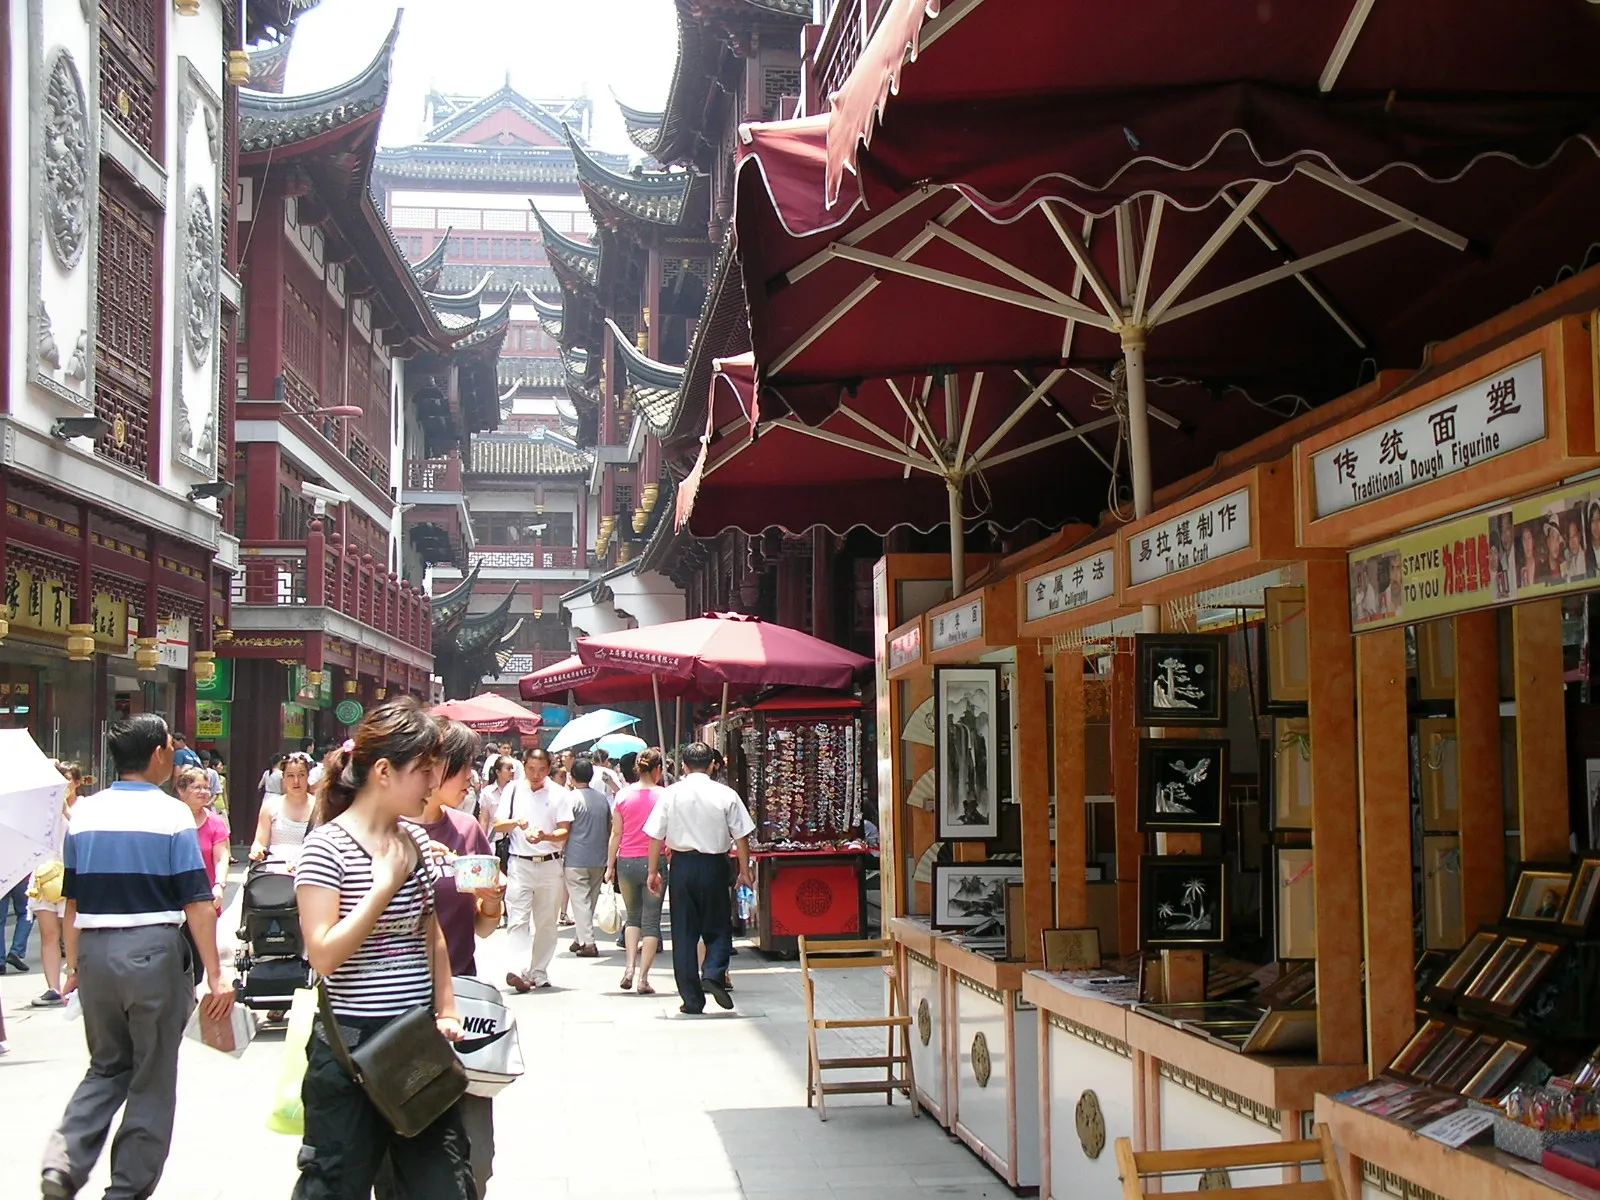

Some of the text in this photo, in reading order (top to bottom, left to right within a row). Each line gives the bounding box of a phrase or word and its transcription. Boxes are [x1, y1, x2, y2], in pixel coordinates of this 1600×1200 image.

[1333, 377, 1521, 484] 传统面塑
[1352, 432, 1500, 501] Traditional Dough Figurine
[1138, 503, 1237, 562] 易拉罐制作
[1165, 545, 1209, 573] Tin Can Craft
[1402, 549, 1440, 576] STATVE
[1035, 558, 1105, 602] 金属书法
[1404, 580, 1439, 602] TO YOU
[463, 1016, 497, 1035] NIKE
